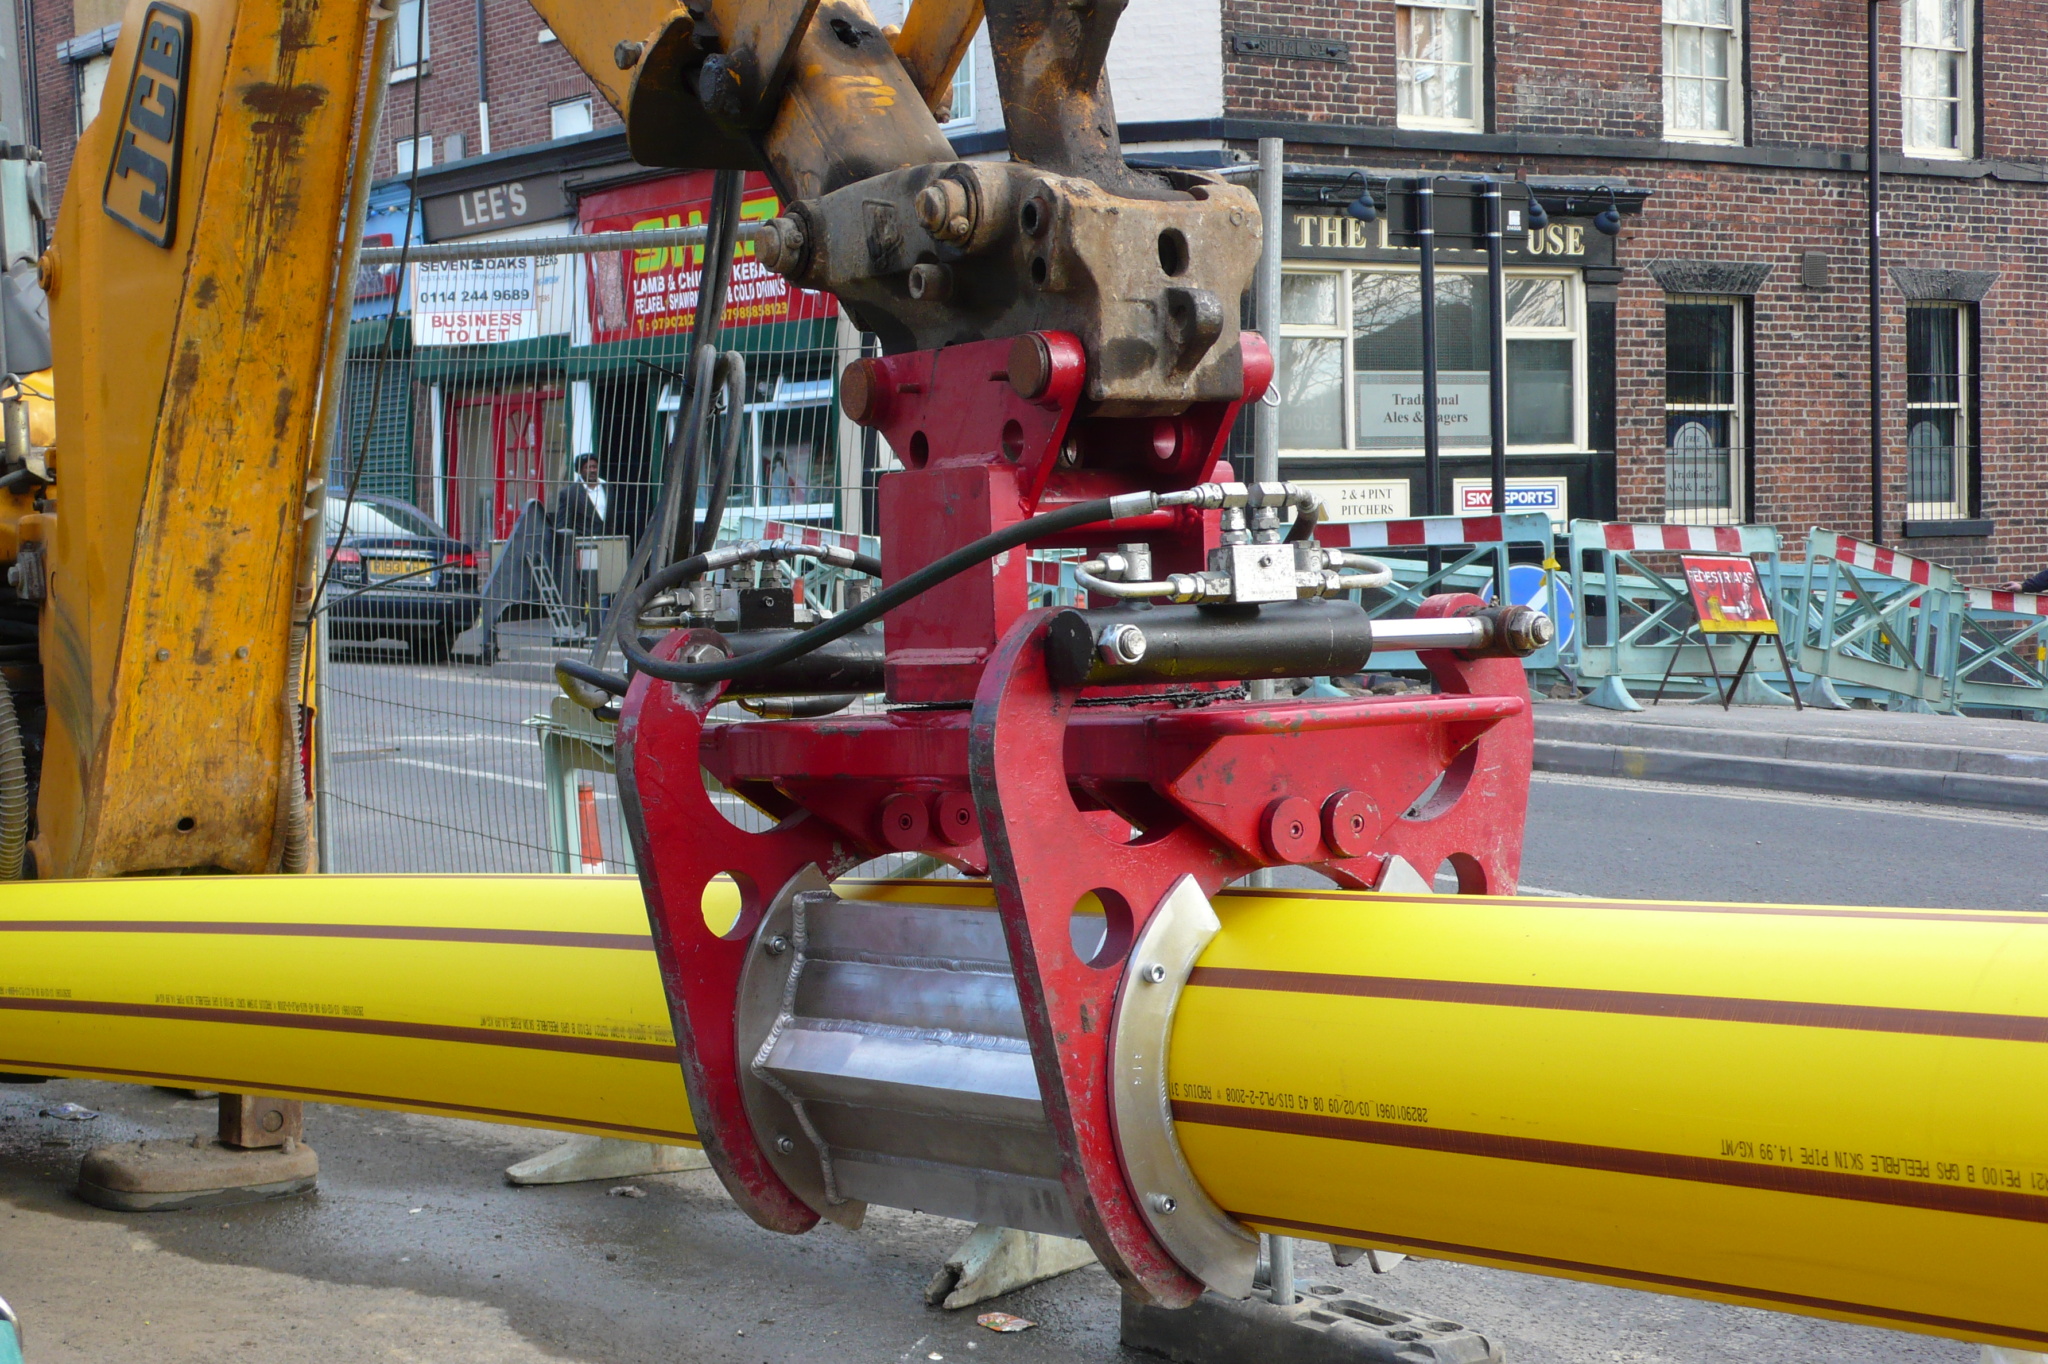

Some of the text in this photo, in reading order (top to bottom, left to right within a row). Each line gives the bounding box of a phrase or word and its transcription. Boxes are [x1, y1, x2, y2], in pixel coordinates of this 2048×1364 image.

[1259, 38, 1304, 56] SPITAL
[115, 20, 182, 224] JCB
[459, 182, 527, 227] LEE'S
[1294, 214, 1367, 248] THE
[420, 258, 527, 272] SEVEN OAKS
[633, 276, 665, 296] LAMB
[734, 282, 755, 301] COLD
[756, 278, 785, 299] DRINKS
[420, 289, 529, 303] 0114 244 9689
[431, 313, 522, 328] BUSINESS
[445, 328, 509, 343] TO LET
[1392, 393, 1459, 406] Tradional
[1384, 411, 1468, 426] Ales & agers
[1341, 488, 1392, 500] 2 & 4 PINT
[1466, 489, 1553, 505] SKY SPORTS
[1341, 504, 1393, 516] PITCHERS
[1183, 1083, 1212, 1100] RADIUS
[1226, 1088, 1294, 1108] GIS/PL2-2-2008
[1328, 1098, 1370, 1117] 03/02/09
[1375, 1103, 1428, 1123] 2829010961
[1720, 1139, 1754, 1158] KG/MT
[1760, 1143, 1793, 1163] 14.99
[1800, 1147, 1829, 1167] PIPE
[1835, 1151, 1864, 1171] SKIN
[1871, 1155, 1930, 1178] PEELABLE
[1936, 1161, 1960, 1182] GAS
[1966, 1165, 1976, 1183] B
[1982, 1167, 2021, 1189] PE100
